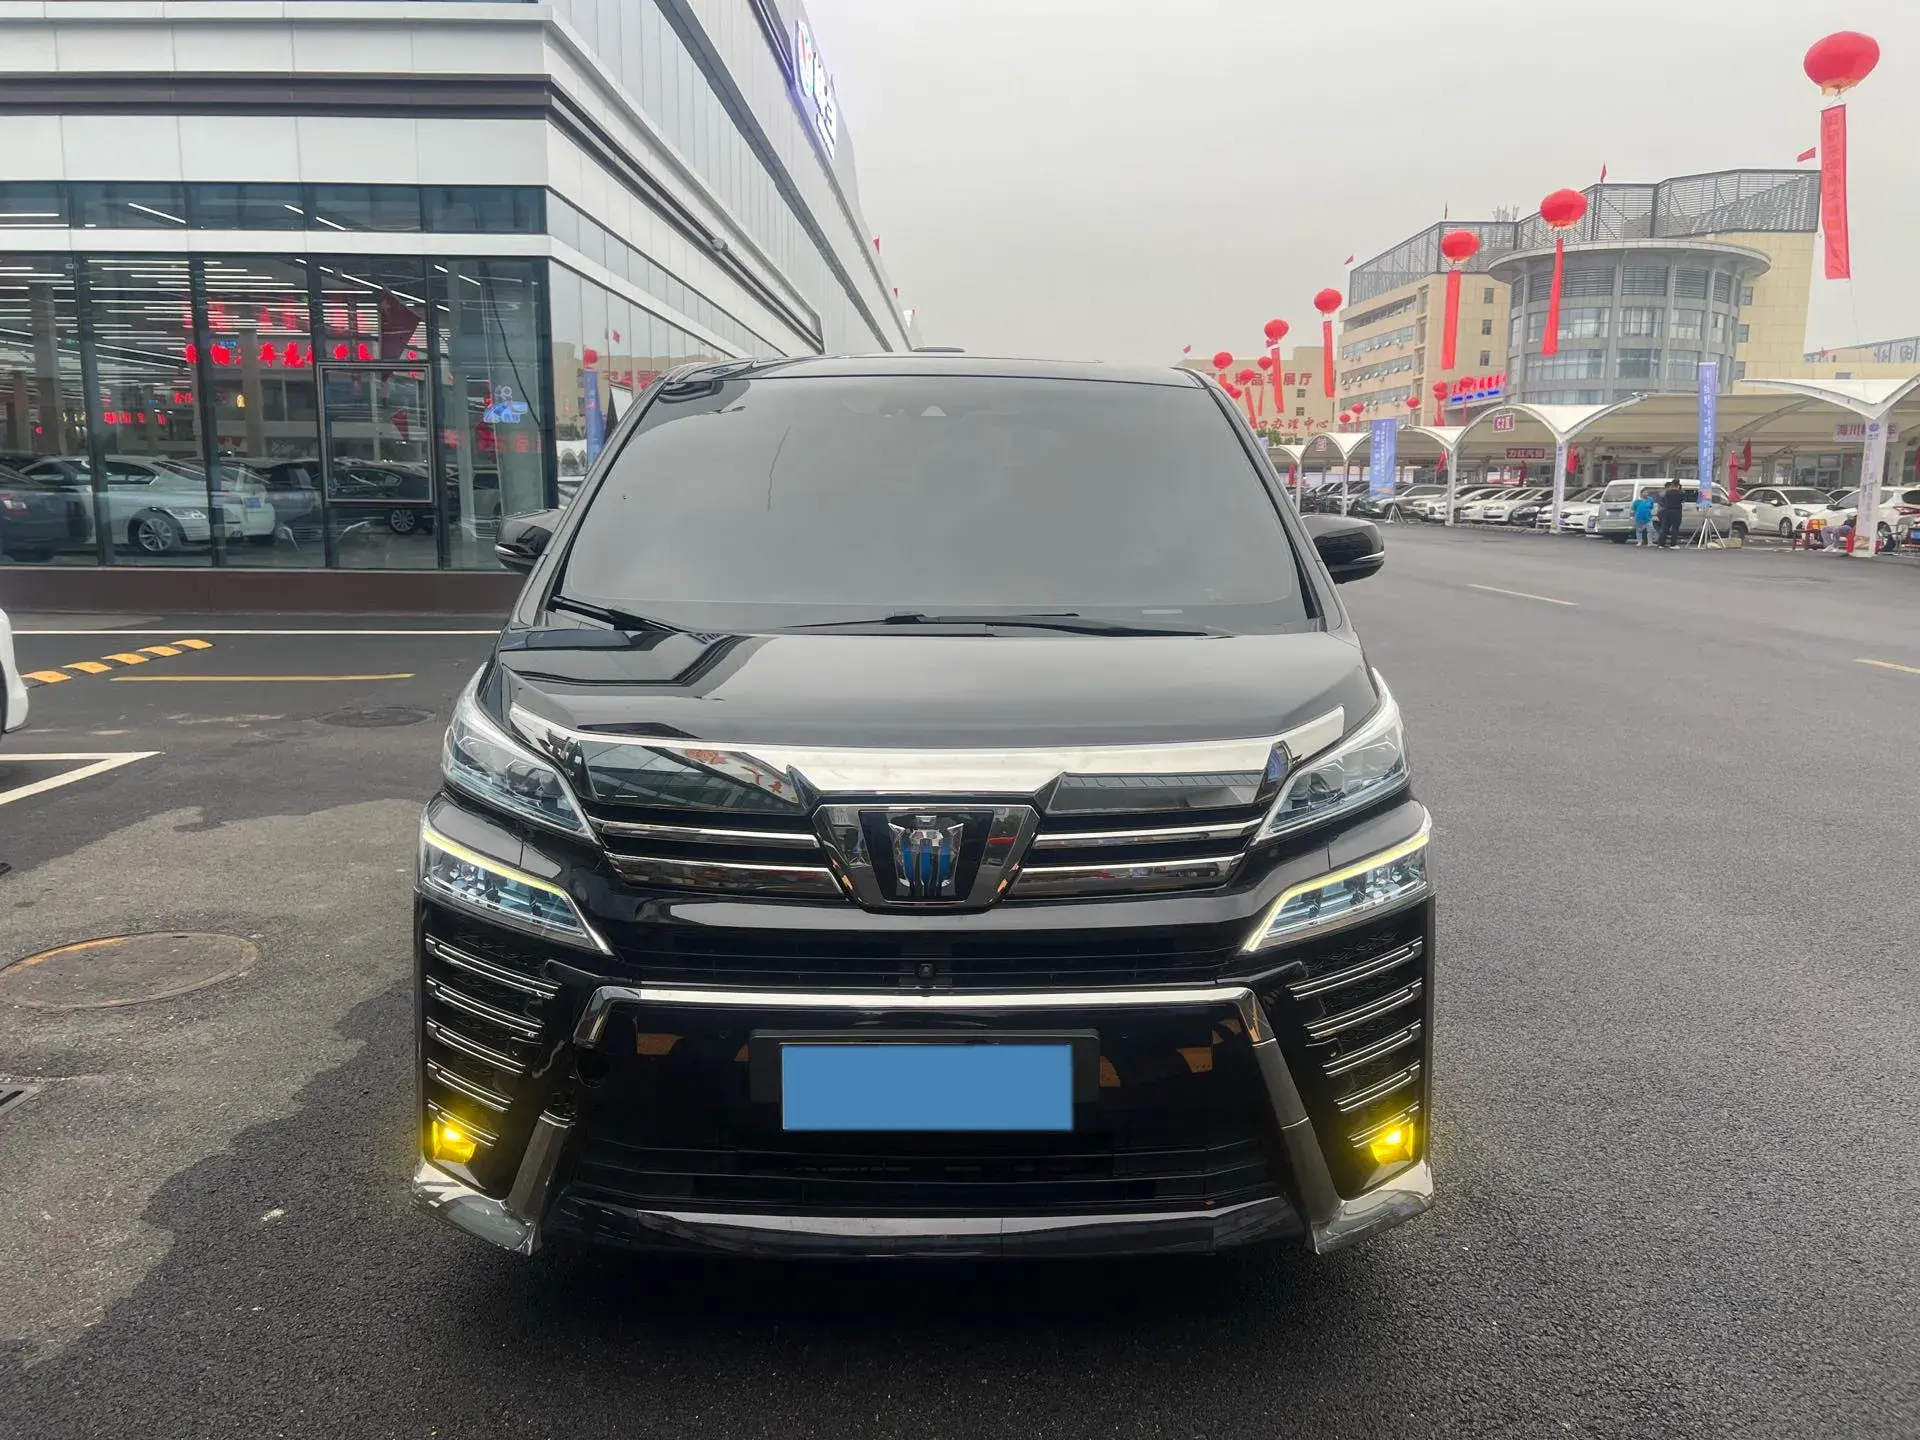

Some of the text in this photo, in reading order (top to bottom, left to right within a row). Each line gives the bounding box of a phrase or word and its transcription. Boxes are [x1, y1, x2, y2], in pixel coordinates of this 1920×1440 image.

[1250, 417, 1329, 430] 口办理中心
